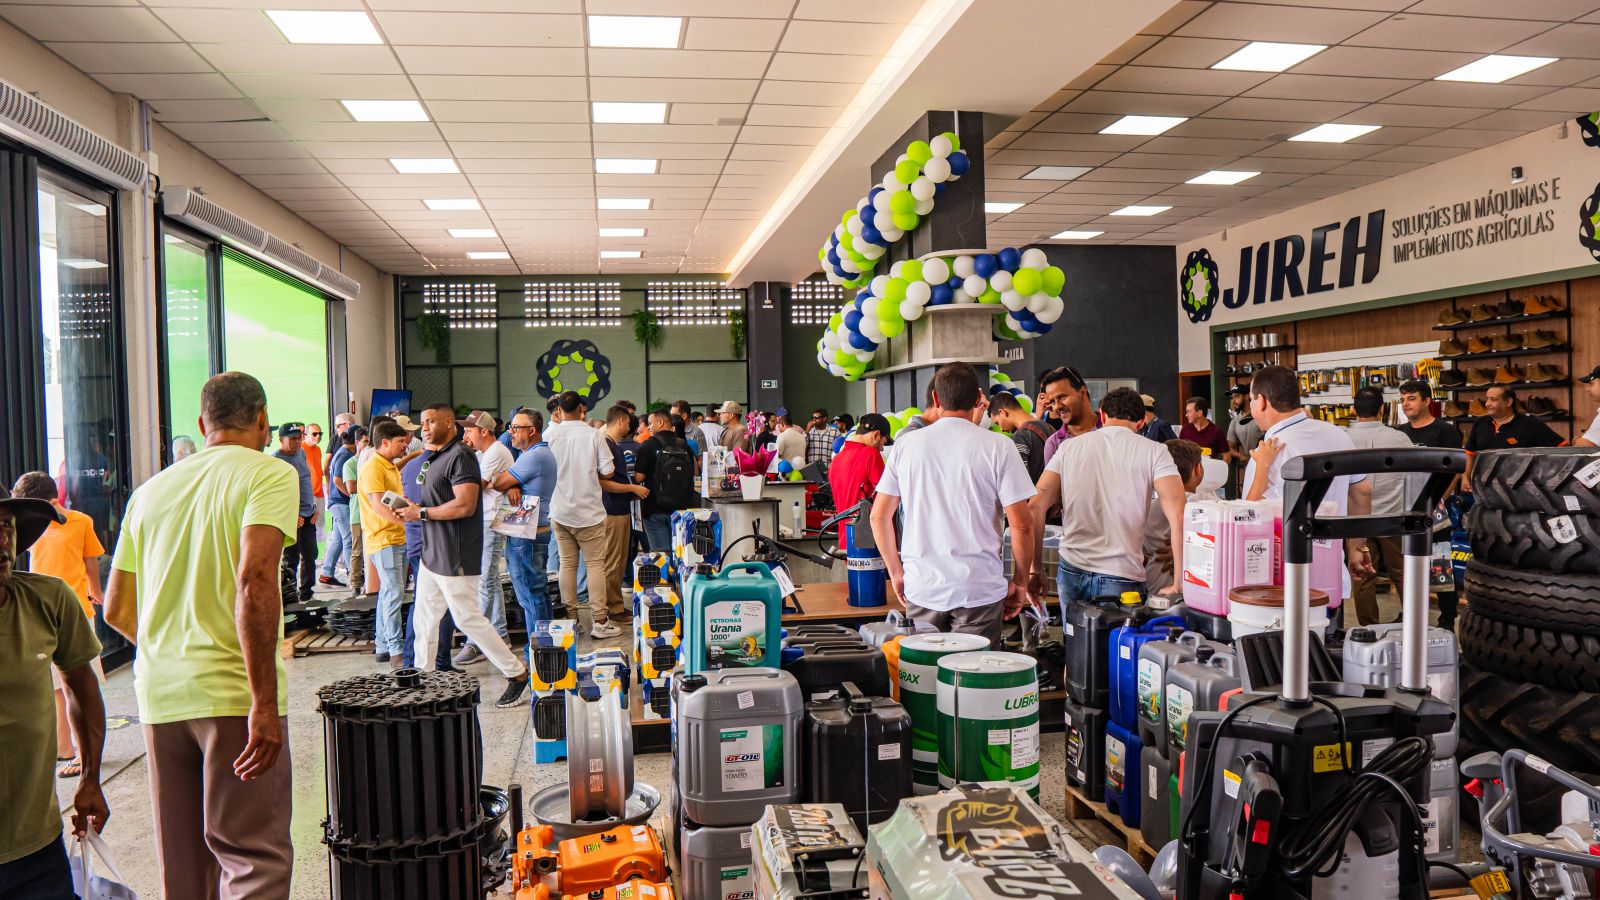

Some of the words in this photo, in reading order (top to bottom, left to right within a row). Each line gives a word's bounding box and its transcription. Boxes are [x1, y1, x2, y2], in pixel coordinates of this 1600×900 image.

[1392, 205, 1451, 238] SOLUÇÕES
[1453, 200, 1471, 224] EM
[1474, 180, 1549, 218] MÁQUINAS
[1552, 177, 1561, 200] E
[1393, 227, 1474, 264] IMPLEMENTOS
[1476, 209, 1555, 247] AGRÍCOLAS
[1222, 208, 1386, 309] JIREH
[710, 624, 742, 633] Urania
[725, 753, 760, 763] GT-OIL
[725, 772, 748, 780] 10W30
